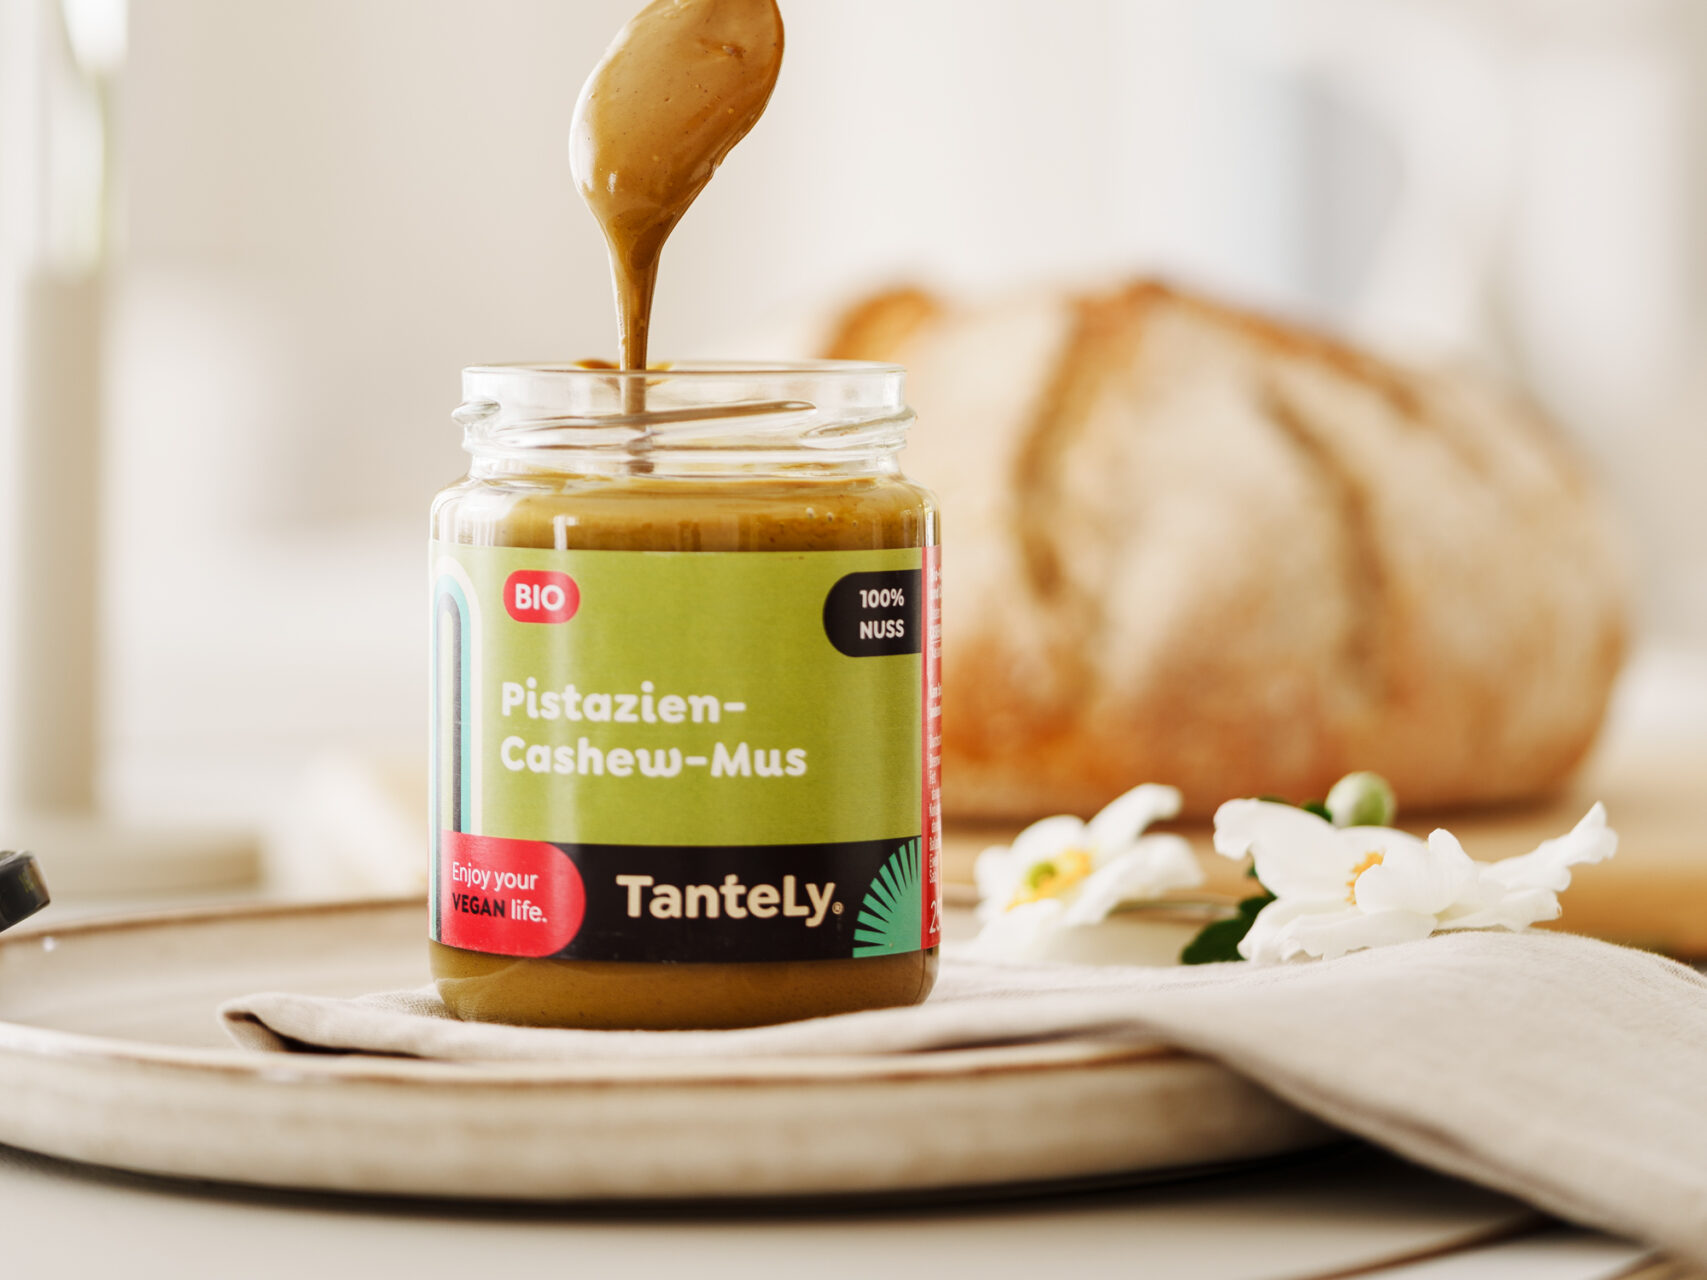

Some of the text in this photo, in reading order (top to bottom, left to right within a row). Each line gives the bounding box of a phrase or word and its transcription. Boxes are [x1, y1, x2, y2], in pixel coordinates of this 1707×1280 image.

[515, 583, 566, 611] BIO
[859, 588, 904, 608] 100%
[859, 619, 904, 640] NUSS
[502, 677, 746, 724] Pistazien-
[500, 736, 807, 778] Cashew-Mus
[452, 861, 538, 891] Enjoy your
[452, 893, 548, 924] VEGAN life.
